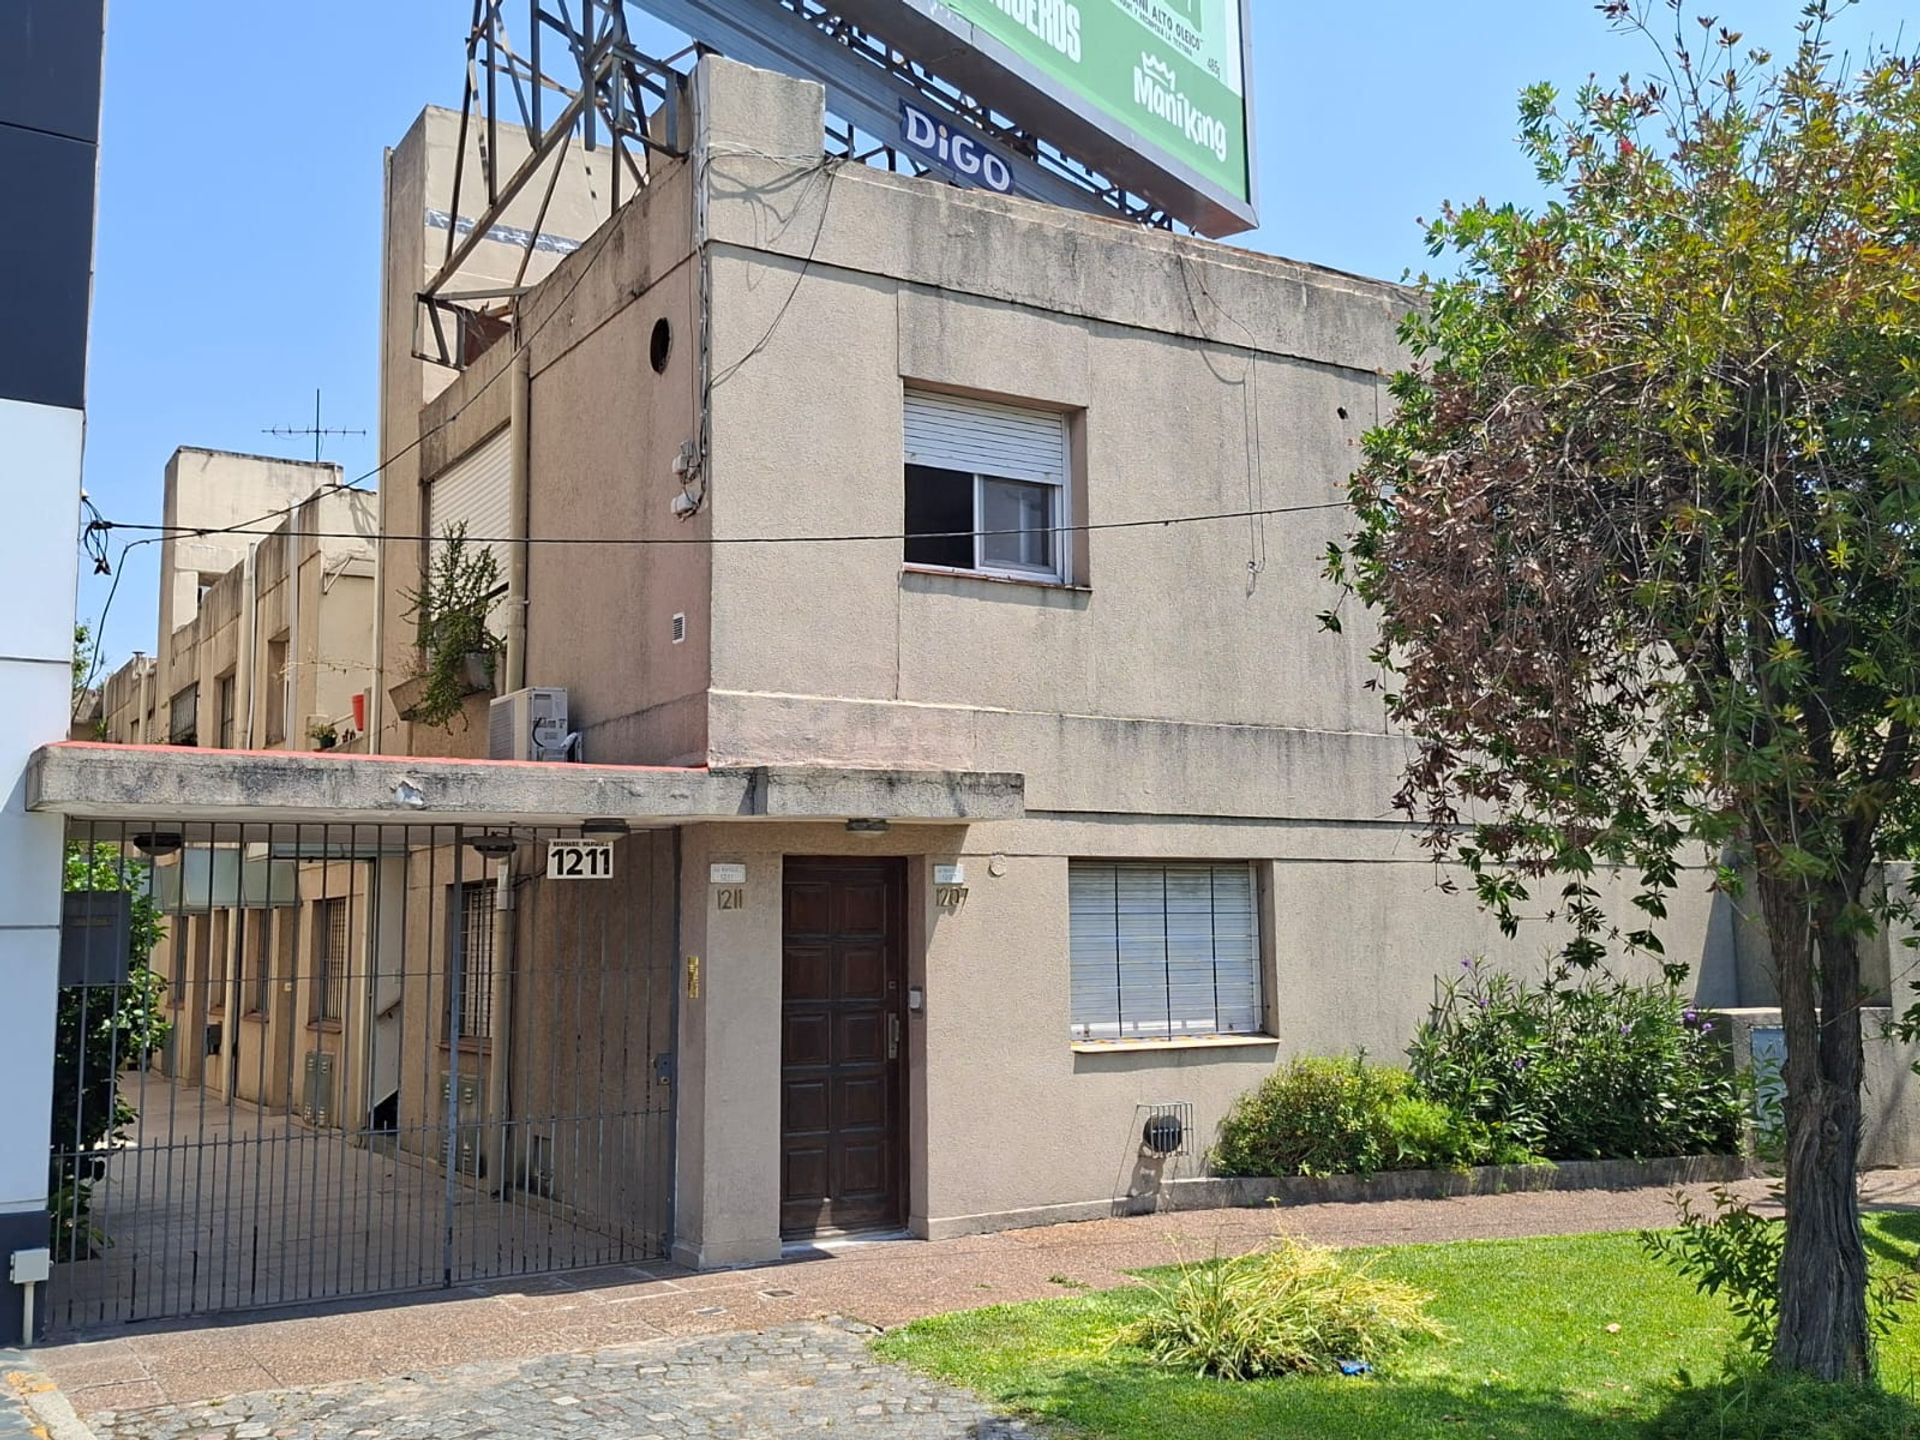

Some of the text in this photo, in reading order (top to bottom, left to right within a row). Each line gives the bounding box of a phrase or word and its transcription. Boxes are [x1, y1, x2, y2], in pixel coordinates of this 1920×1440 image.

[1152, 5, 1173, 31] ALTO
[1175, 22, 1200, 51] OLEICO
[551, 848, 610, 875] 1211
[717, 888, 743, 910] 1211
[936, 887, 970, 912] 1207
